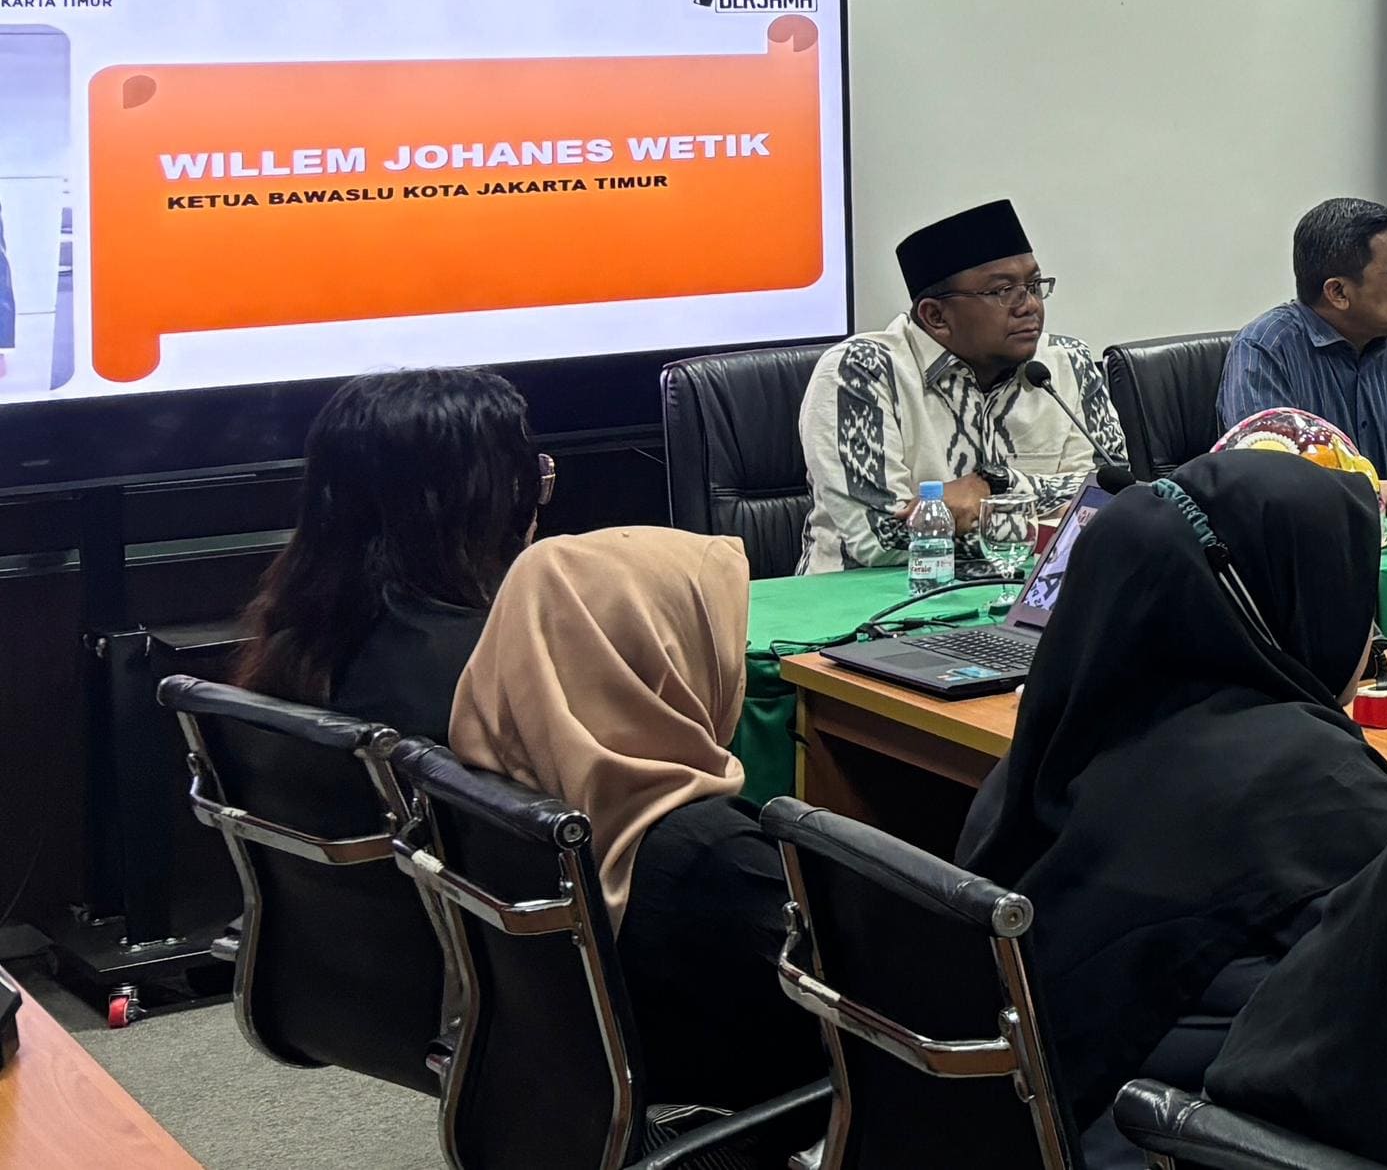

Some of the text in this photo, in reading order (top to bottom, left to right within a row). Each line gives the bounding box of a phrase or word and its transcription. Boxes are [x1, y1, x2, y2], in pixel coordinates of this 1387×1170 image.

[160, 133, 770, 180] WILLEM JOHANES WETIK
[168, 175, 668, 210] KETUA BAWASLU KOTA JAKARTA TIMUR
